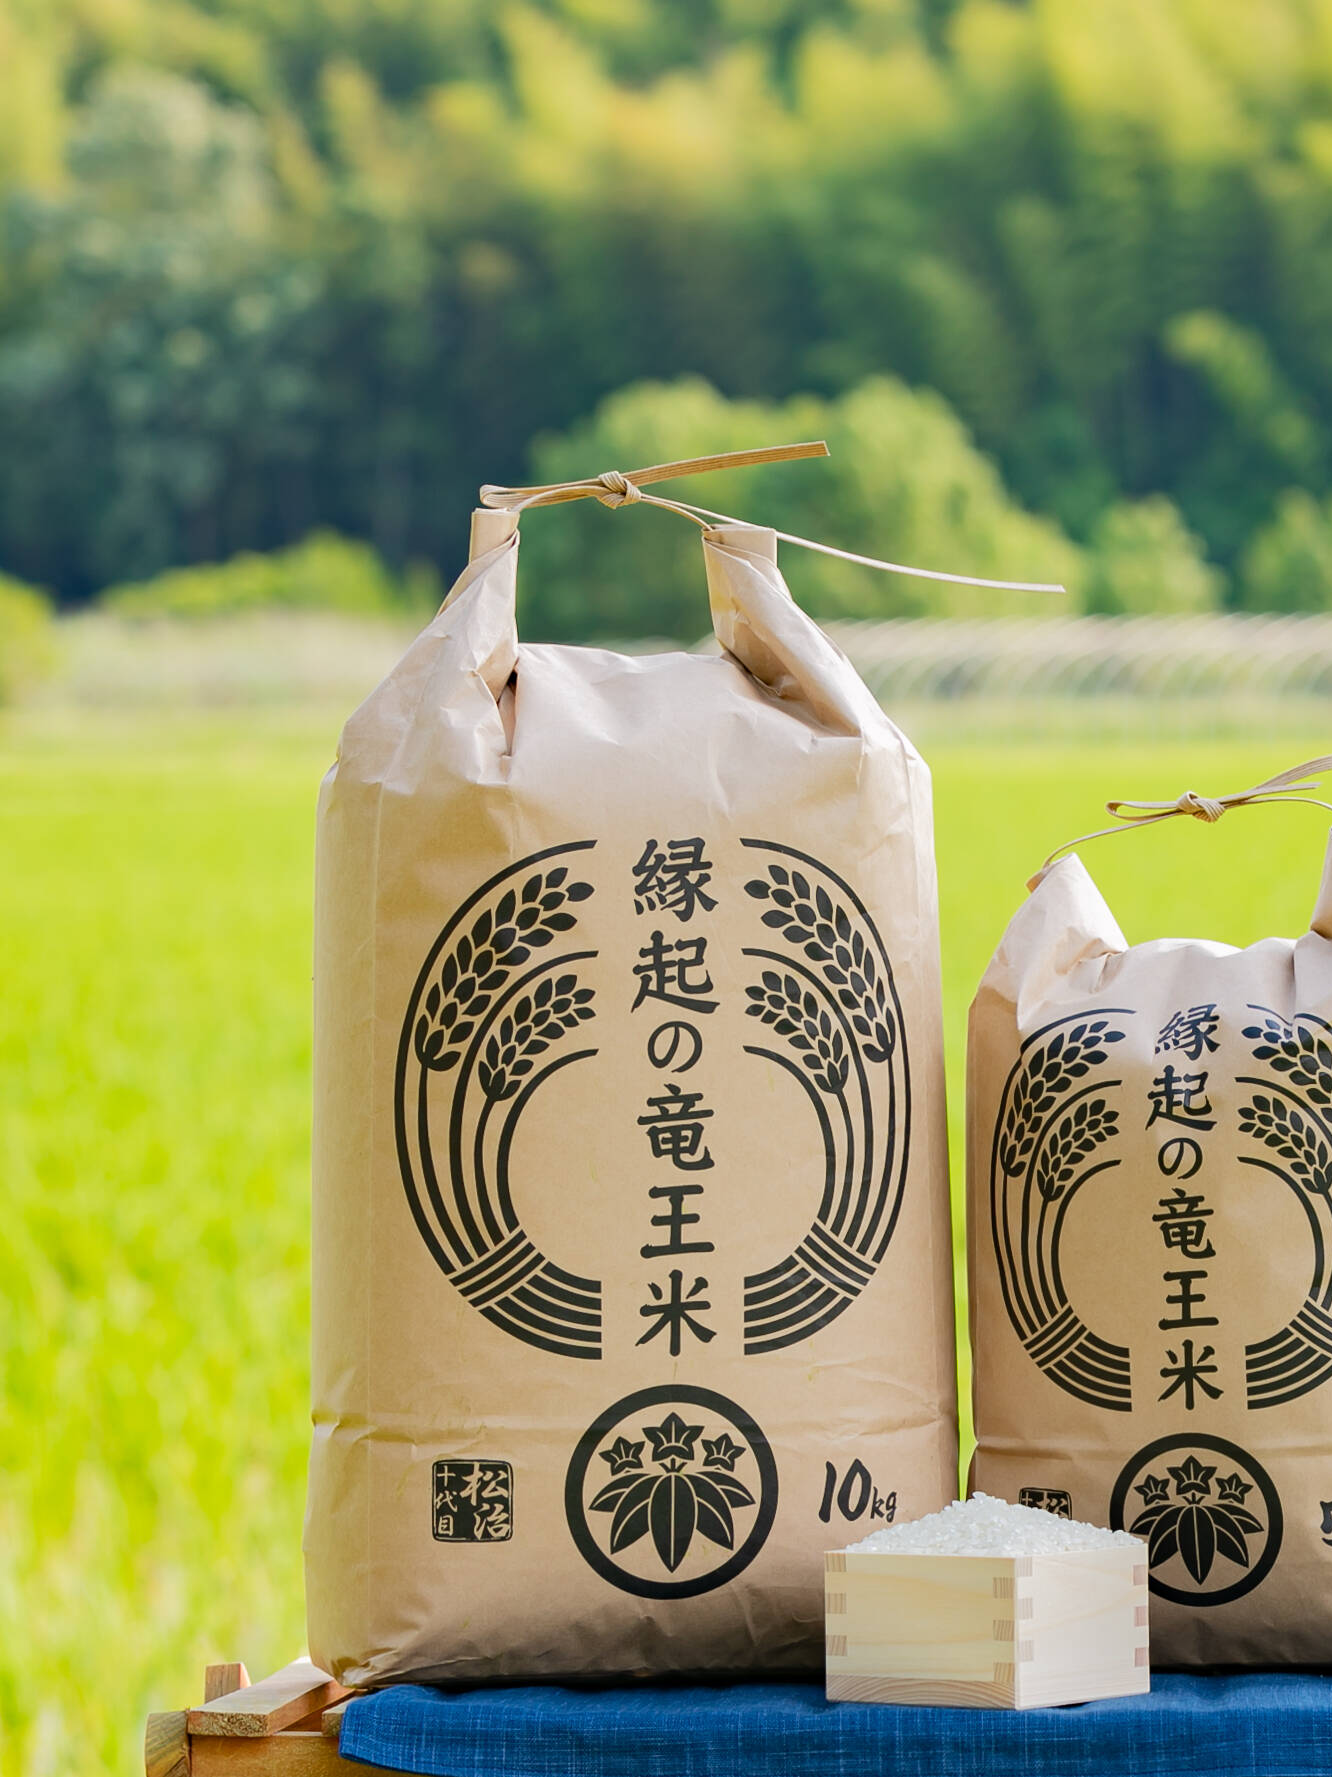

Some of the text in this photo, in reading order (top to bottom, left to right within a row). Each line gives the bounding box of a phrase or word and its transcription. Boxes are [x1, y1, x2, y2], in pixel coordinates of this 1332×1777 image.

[630, 837, 721, 1357] 縁起の竜王米
[1144, 1003, 1225, 1411] 縁起の竜王米
[435, 1464, 458, 1537] 十代目
[459, 1461, 510, 1541] 松治
[818, 1457, 898, 1524] 10kg
